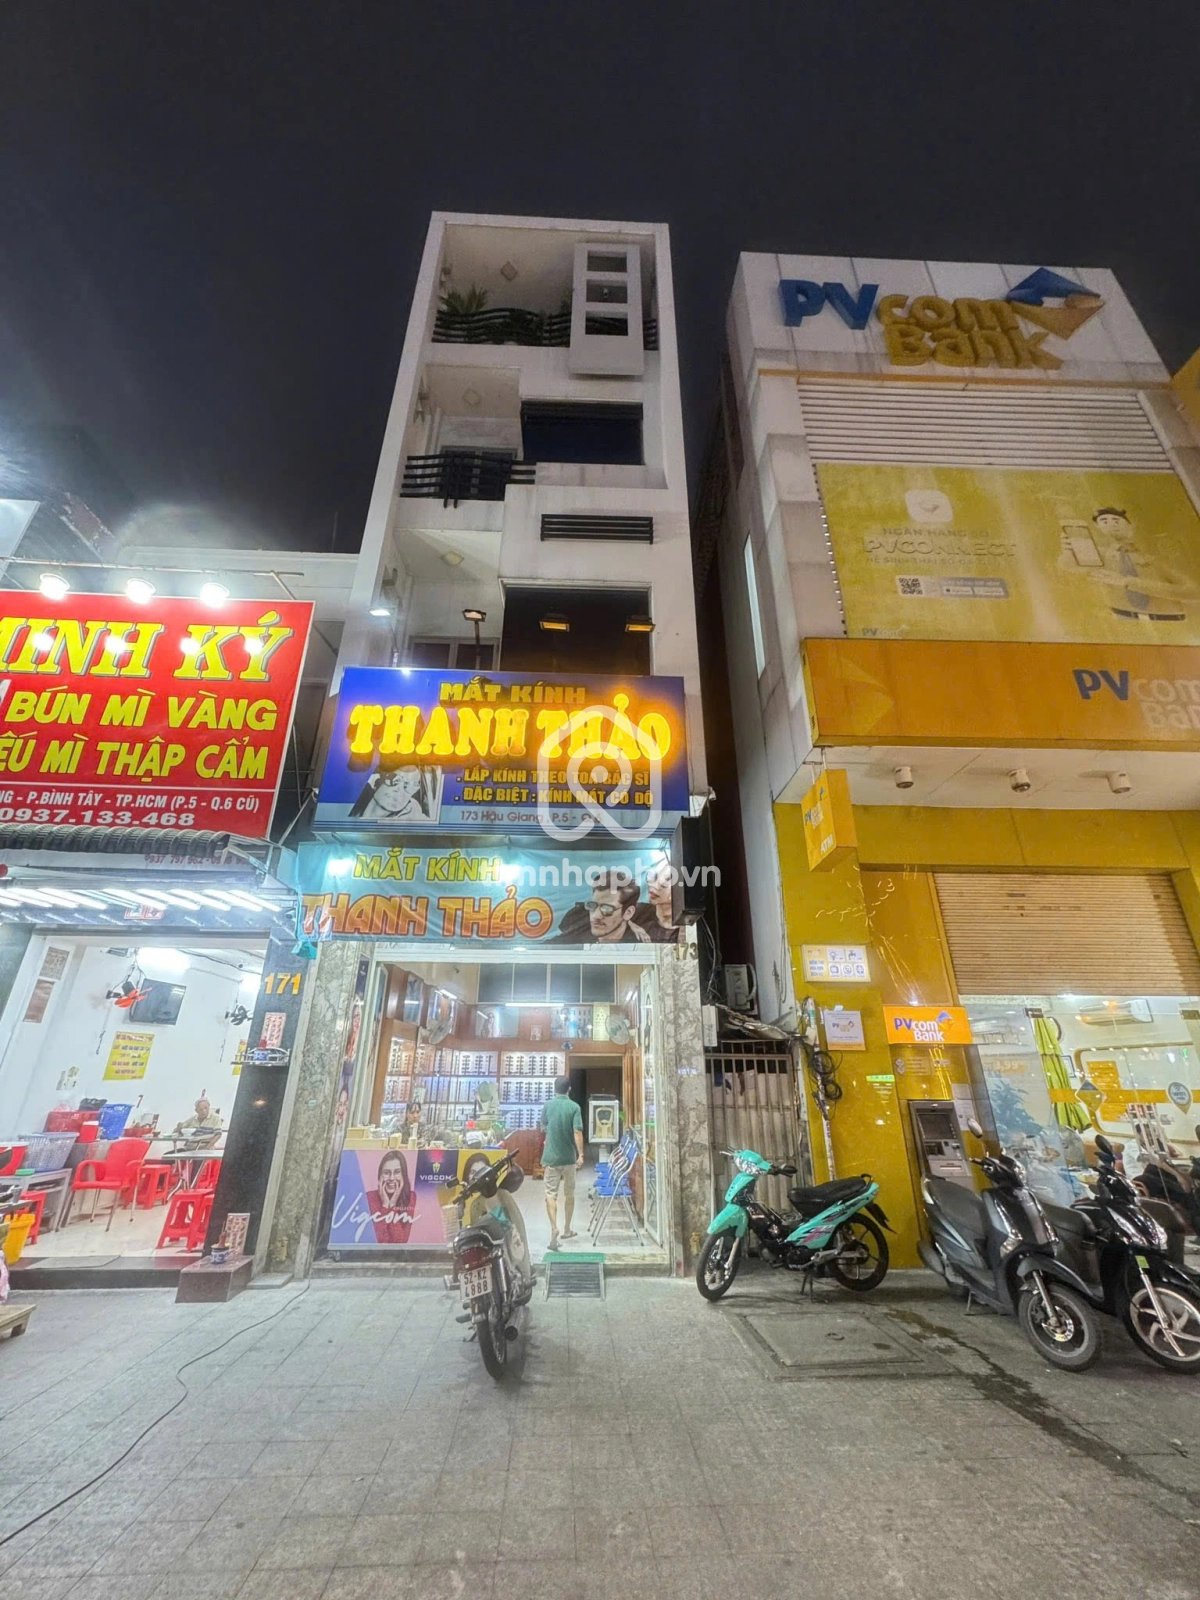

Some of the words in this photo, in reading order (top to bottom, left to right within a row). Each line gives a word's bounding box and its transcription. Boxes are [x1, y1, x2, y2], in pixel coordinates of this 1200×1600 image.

[884, 324, 1064, 369] Bank
[173, 610, 294, 682] KÝ
[440, 676, 502, 702] MẮT
[511, 682, 586, 704] KÍNH
[4, 685, 92, 725] BÚN
[99, 688, 156, 728] MÌ
[168, 690, 278, 731] VÀNG
[350, 704, 529, 757] THANH
[536, 693, 671, 761] THẢO
[39, 732, 90, 774] MÌ
[96, 735, 186, 782] THẬP
[195, 736, 269, 780] CẨM
[493, 767, 526, 783] KÍNH
[531, 769, 567, 785] THEO
[572, 771, 599, 786] TOA
[26, 788, 74, 805] P.BÌNH
[77, 790, 104, 806] TÂY
[115, 794, 168, 809] TP.HCM
[211, 797, 232, 811] Q.6
[236, 795, 260, 813] CŨ)
[463, 785, 493, 804] ĐẶC
[496, 786, 529, 805] BIỆT
[539, 787, 574, 804] KÍNH
[576, 788, 606, 805] MÁT
[634, 790, 654, 806] ĐỘ
[460, 810, 478, 822] 173
[507, 811, 544, 825] Giang
[353, 849, 421, 881] MẮT
[427, 851, 501, 882] KÍNH
[302, 892, 430, 937] THANH
[437, 885, 554, 939] THẢO
[264, 972, 302, 995] 171
[914, 1031, 945, 1042] Bank
[331, 1192, 422, 1243] Vigcom
